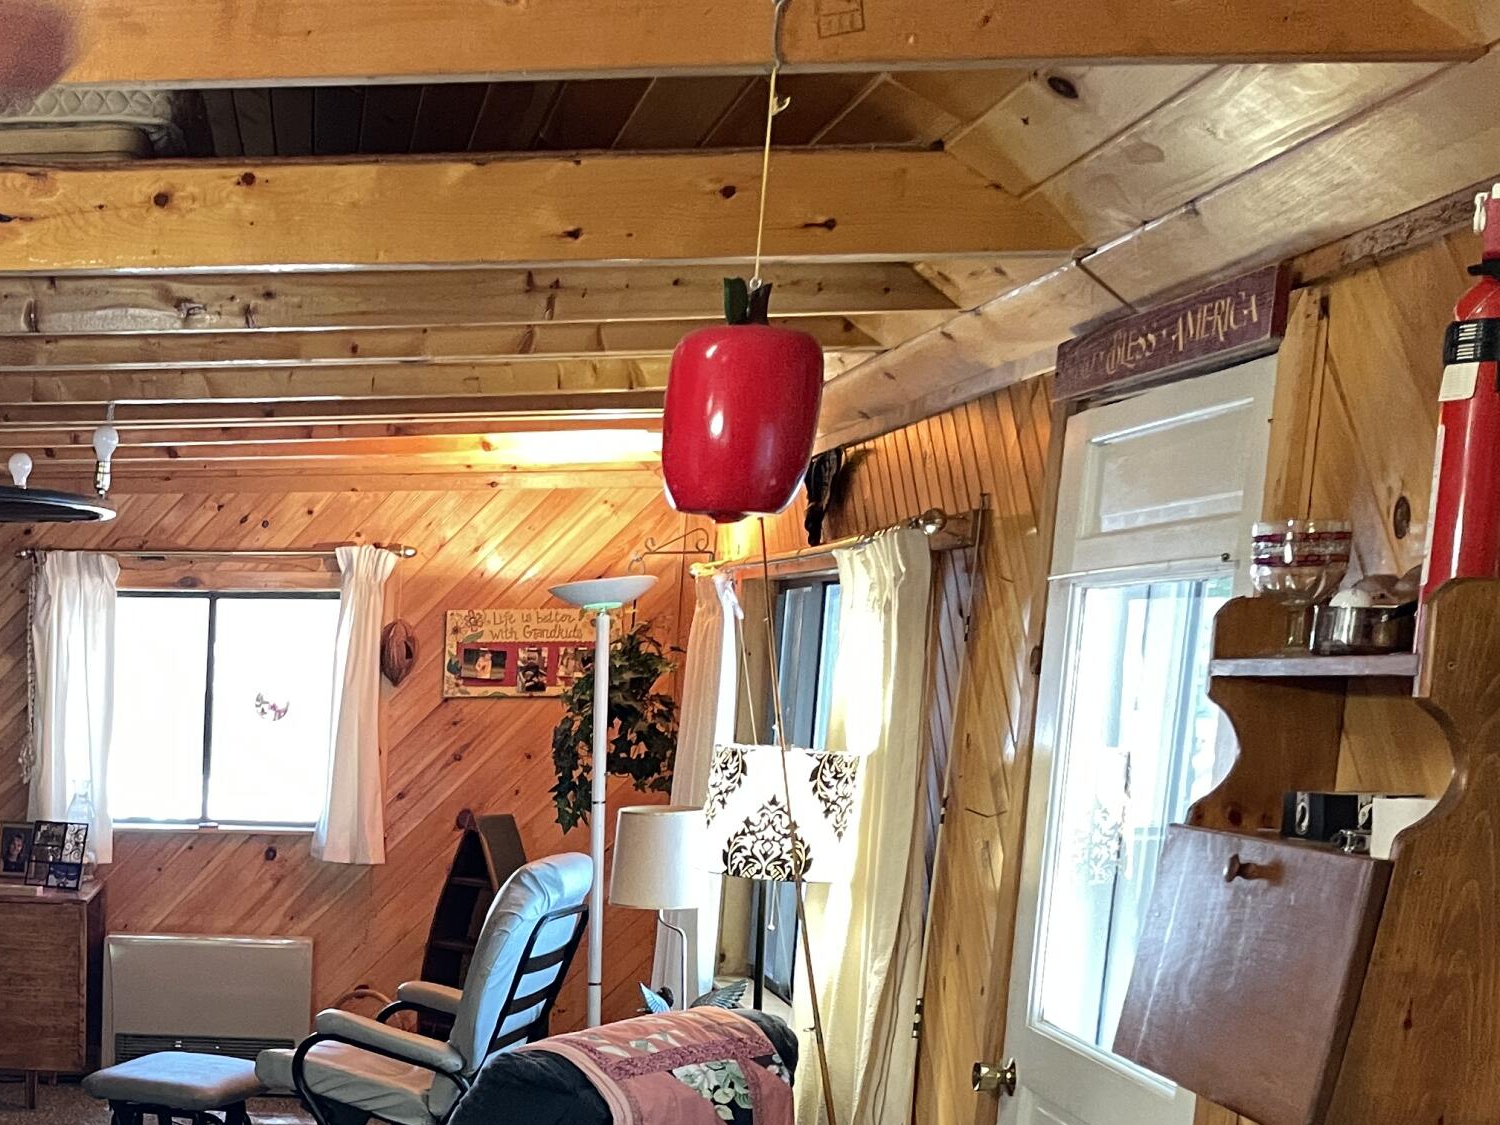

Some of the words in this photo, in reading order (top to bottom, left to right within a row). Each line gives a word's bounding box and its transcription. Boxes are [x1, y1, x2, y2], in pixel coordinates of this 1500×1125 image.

[1169, 291, 1258, 353] AMERICA
[492, 611, 516, 628] Life
[521, 611, 532, 623] is
[489, 627, 518, 641] with
[522, 624, 584, 640] Grandkids
